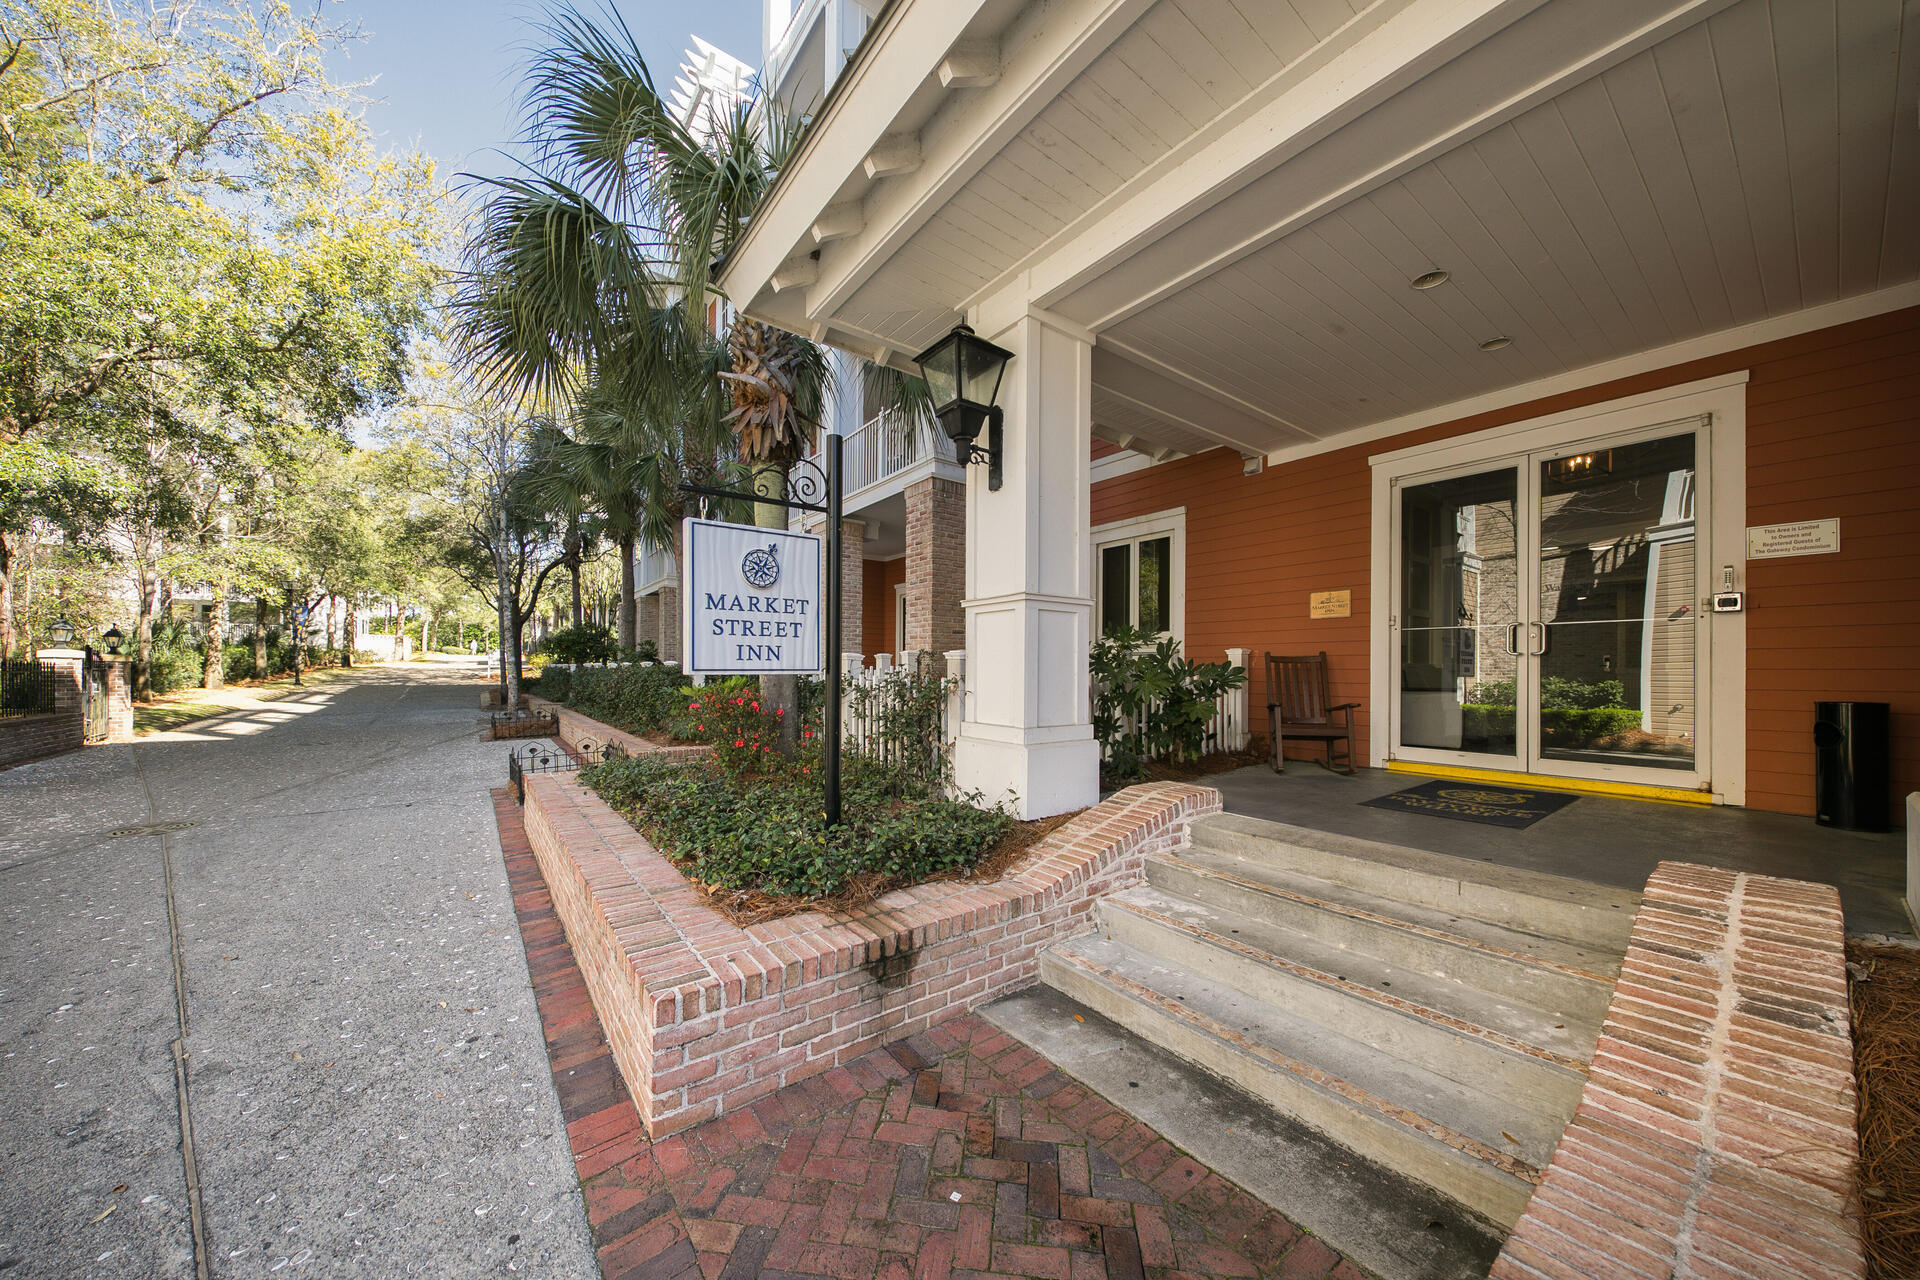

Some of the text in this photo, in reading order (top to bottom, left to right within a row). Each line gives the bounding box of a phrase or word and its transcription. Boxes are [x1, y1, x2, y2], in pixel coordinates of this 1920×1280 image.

[1762, 540, 1792, 548] Registered
[704, 593, 809, 615] MARKET
[712, 618, 803, 638] STREET
[736, 644, 782, 661] INN
